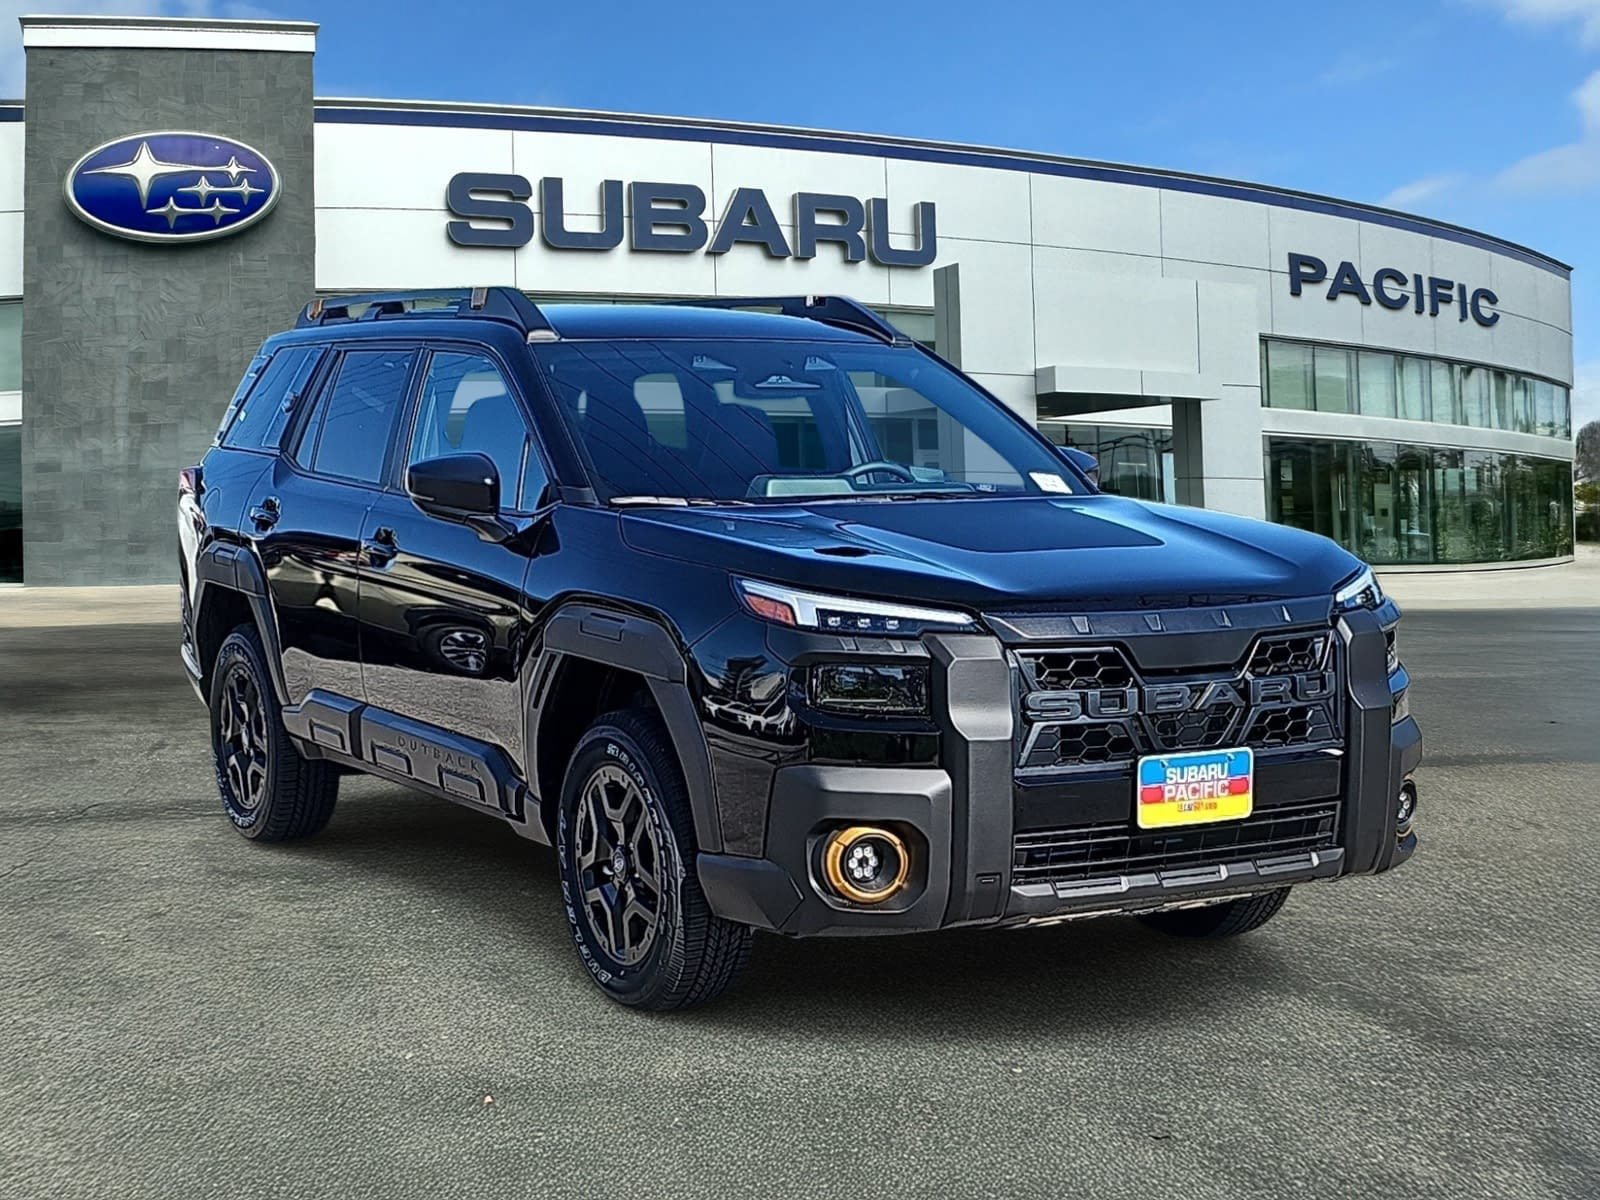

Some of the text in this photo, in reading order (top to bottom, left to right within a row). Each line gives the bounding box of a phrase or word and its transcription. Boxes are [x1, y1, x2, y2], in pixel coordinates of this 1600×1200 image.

[446, 171, 937, 268] SUBARU
[1288, 252, 1500, 328] PACIFIC
[1026, 671, 1336, 720] SUBARU
[397, 735, 480, 773] OUTBACK
[1166, 762, 1229, 785] SUBARU
[1164, 779, 1230, 803] PACIFIC
